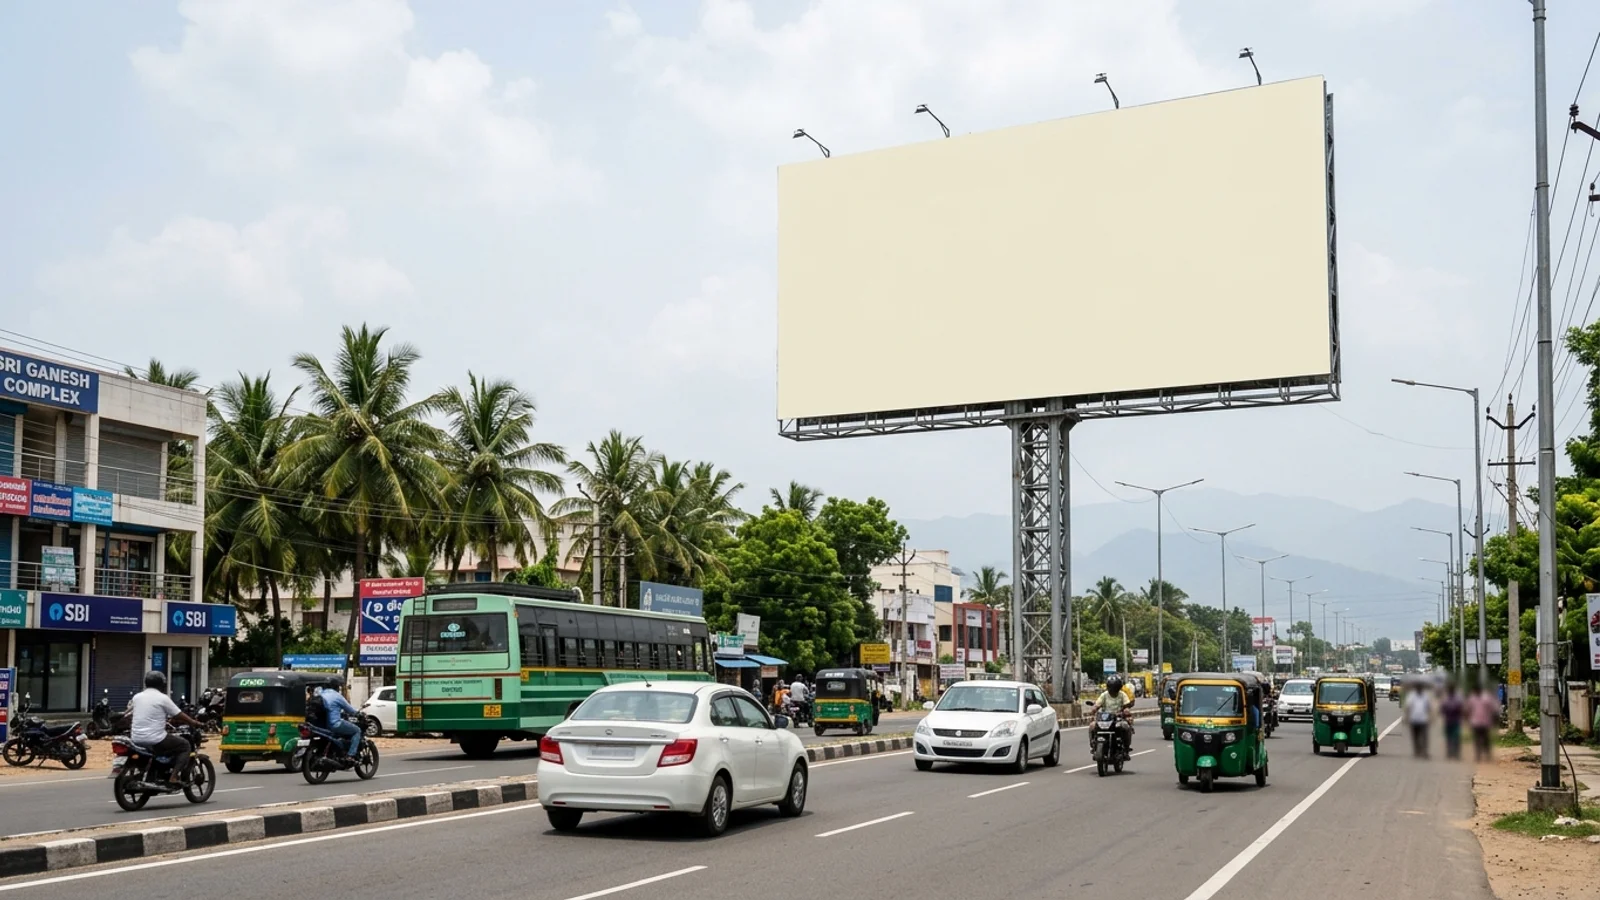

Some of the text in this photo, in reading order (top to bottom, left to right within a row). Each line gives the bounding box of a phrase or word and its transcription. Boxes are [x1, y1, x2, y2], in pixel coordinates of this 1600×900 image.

[26, 362, 90, 389] GANESH
[4, 377, 81, 406] COMPLEX
[64, 603, 90, 622] SBI
[185, 610, 206, 628] SBI
